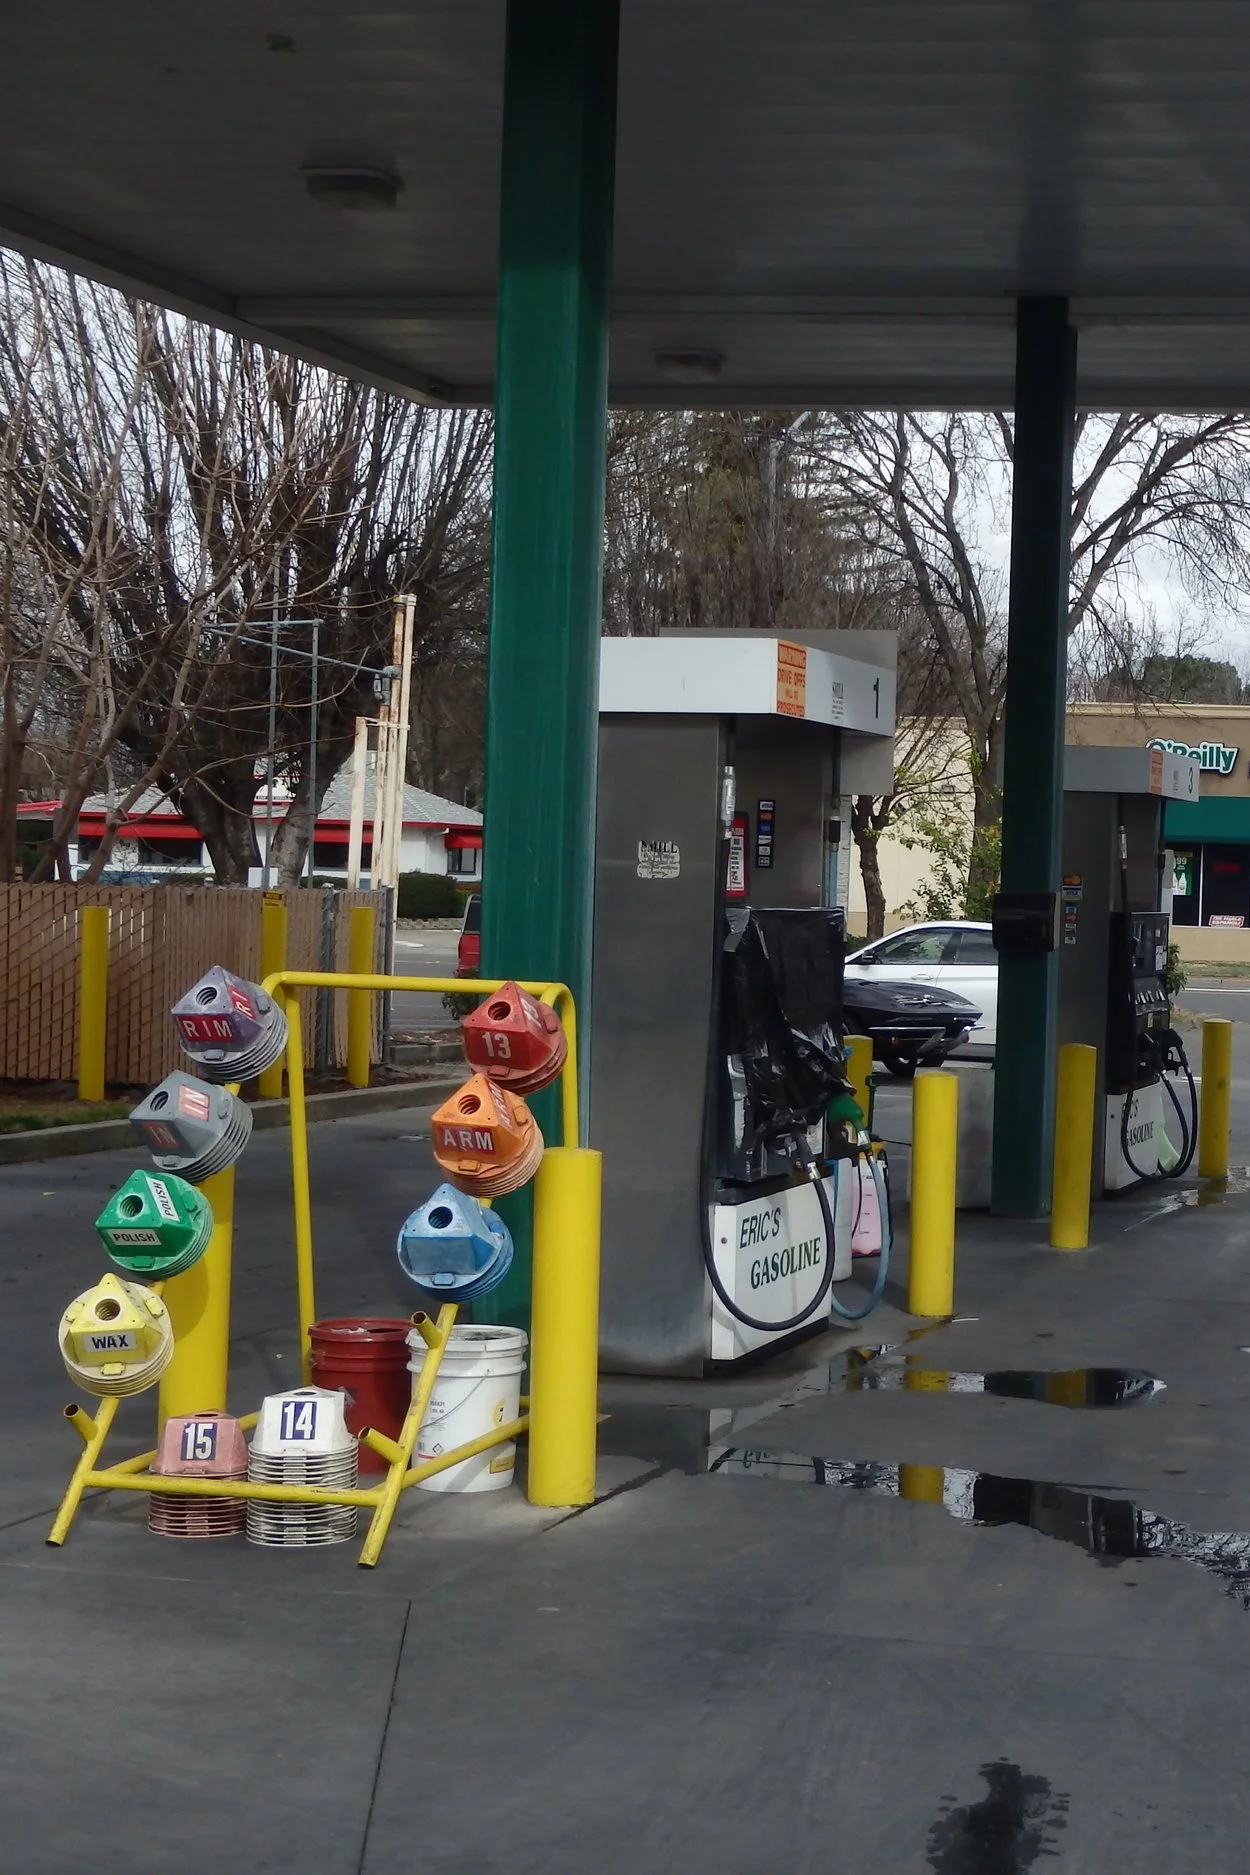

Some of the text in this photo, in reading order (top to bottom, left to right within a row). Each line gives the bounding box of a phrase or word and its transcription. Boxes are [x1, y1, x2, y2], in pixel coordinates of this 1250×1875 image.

[873, 677, 880, 719] 1
[1188, 766, 1194, 794] 3
[182, 1019, 233, 1038] RIM
[482, 1031, 512, 1059] 13
[444, 1129, 493, 1150] ARM
[1125, 1121, 1154, 1147] ASOLINE
[152, 1181, 175, 1217] POLISH
[112, 1233, 156, 1242] POLISH
[739, 1207, 781, 1249] ERIC'S
[750, 1237, 821, 1289] GASOLINE
[91, 1334, 129, 1349] WAX
[284, 1402, 313, 1439] 14
[184, 1422, 214, 1460] 15
